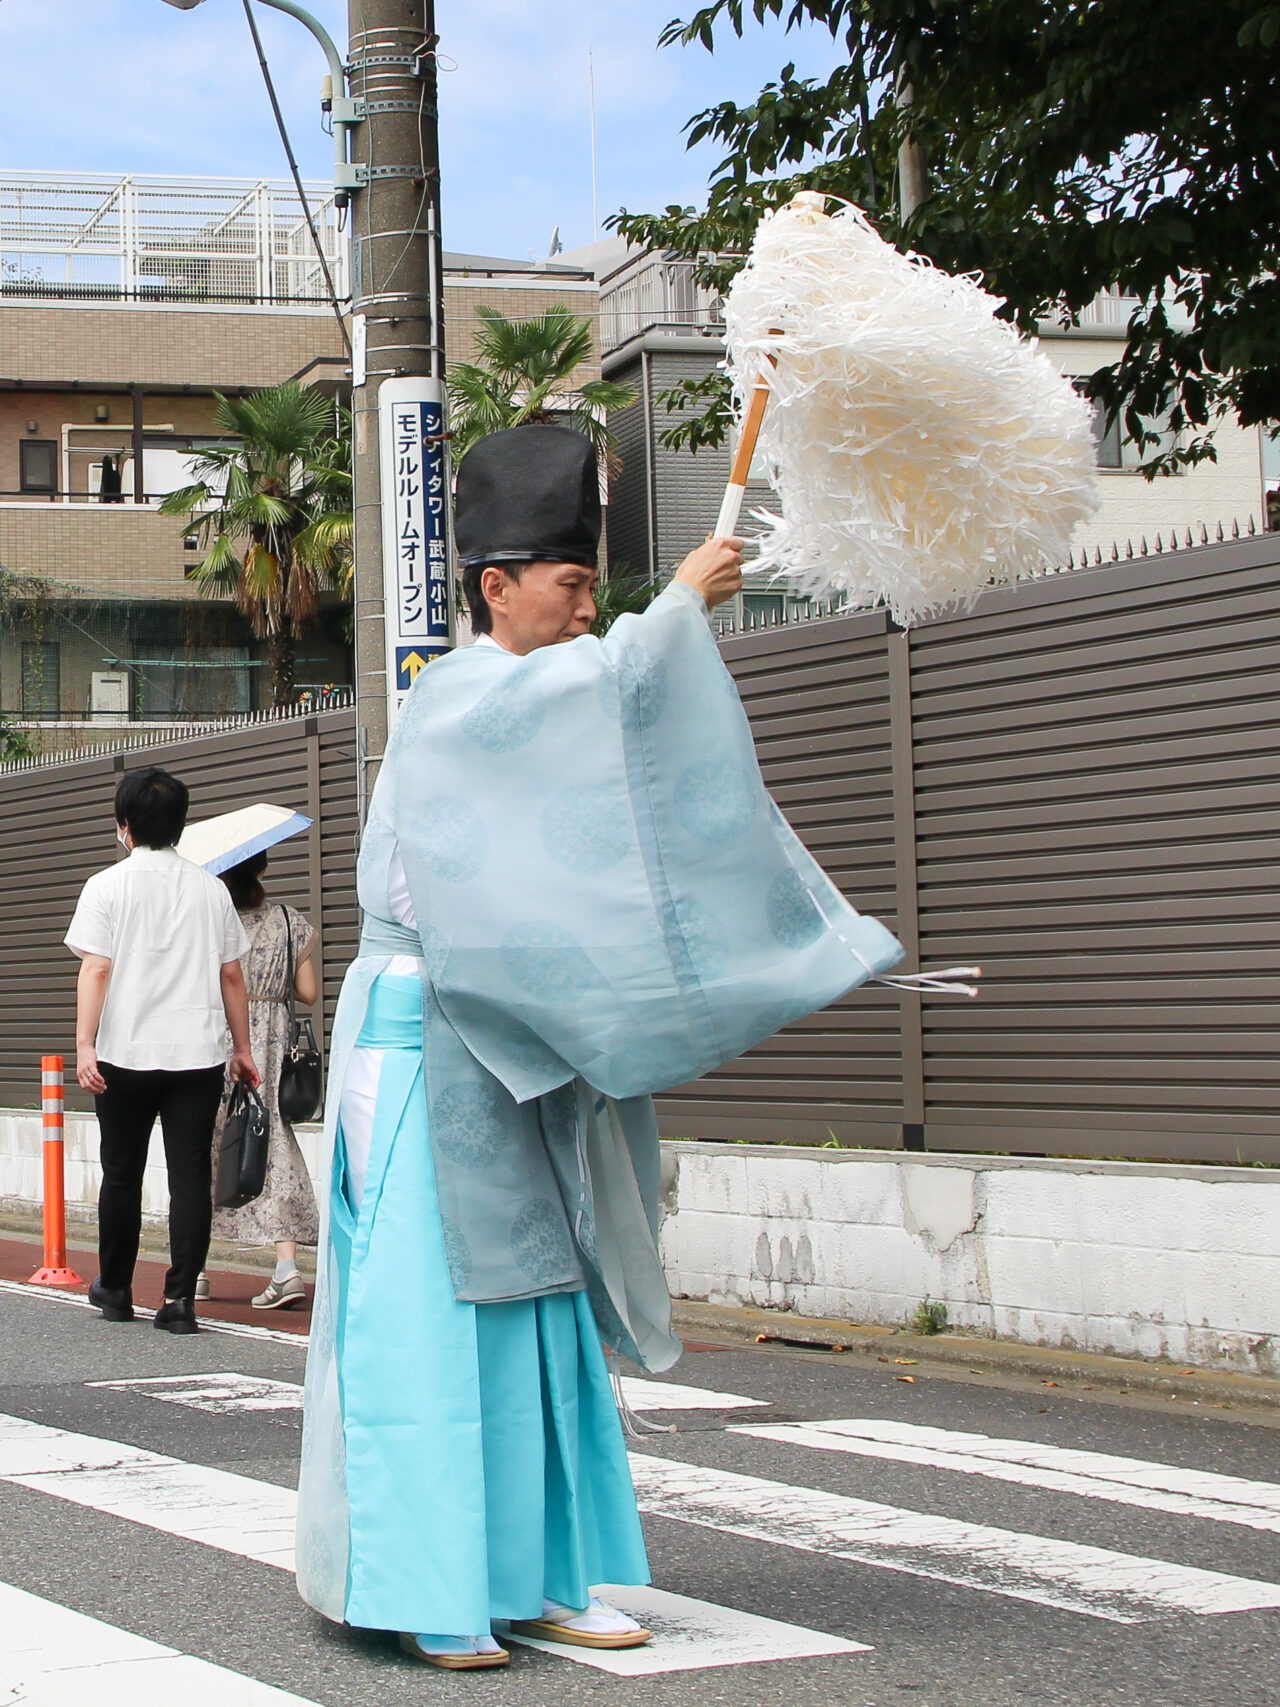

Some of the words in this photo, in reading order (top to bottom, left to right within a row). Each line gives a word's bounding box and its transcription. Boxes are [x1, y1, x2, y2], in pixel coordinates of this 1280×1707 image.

[398, 414, 422, 623] モデルルームオープン
